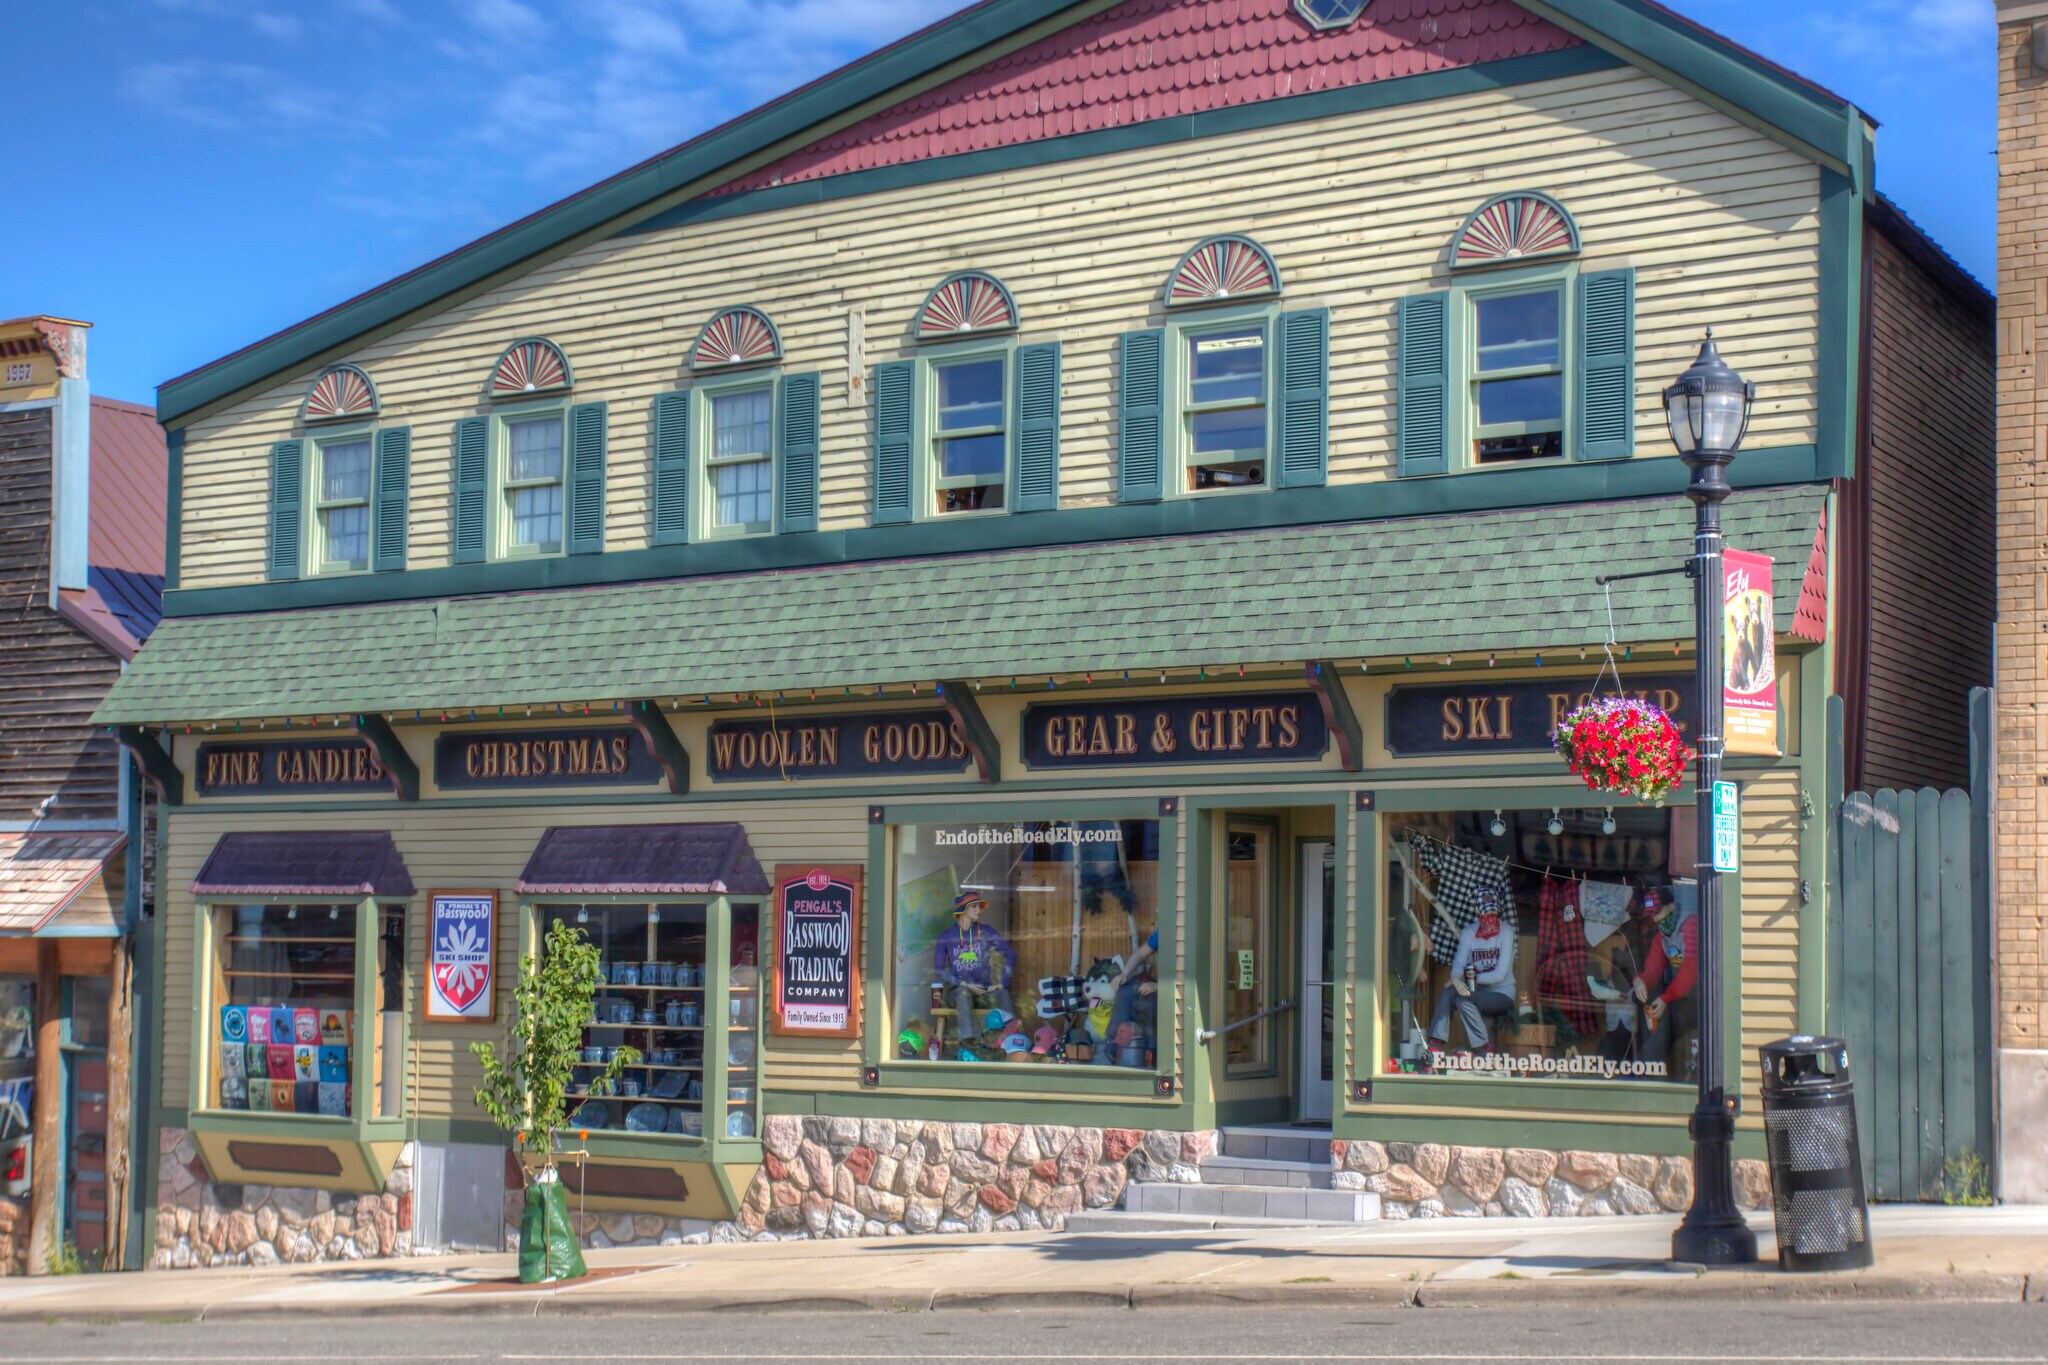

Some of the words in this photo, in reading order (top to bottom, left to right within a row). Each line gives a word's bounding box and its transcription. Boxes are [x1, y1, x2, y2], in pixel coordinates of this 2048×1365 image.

[1726, 568, 1749, 600] Ely
[1045, 713, 1137, 757] GEAR
[1151, 711, 1176, 754] &
[1190, 704, 1299, 751] GIFTS
[1441, 695, 1512, 740] SKI
[465, 736, 629, 778] CHRISTMAS
[711, 726, 839, 770] WOOLEN
[864, 721, 969, 764] GOODS
[206, 751, 262, 787] FINE
[276, 747, 386, 783] CANDIES
[934, 827, 1123, 847] EndoftheRoadEly.com
[794, 900, 842, 914] PENGAL'S
[786, 911, 849, 956] BASSWOOD
[790, 957, 843, 983] TRADING
[788, 987, 844, 998] COMPANY
[787, 1010, 803, 1025] Family
[802, 1011, 819, 1023] Owned
[819, 1011, 832, 1023] Since
[832, 1012, 844, 1024] 1915
[1433, 1051, 1668, 1078] EndoftheRoadEly.com
